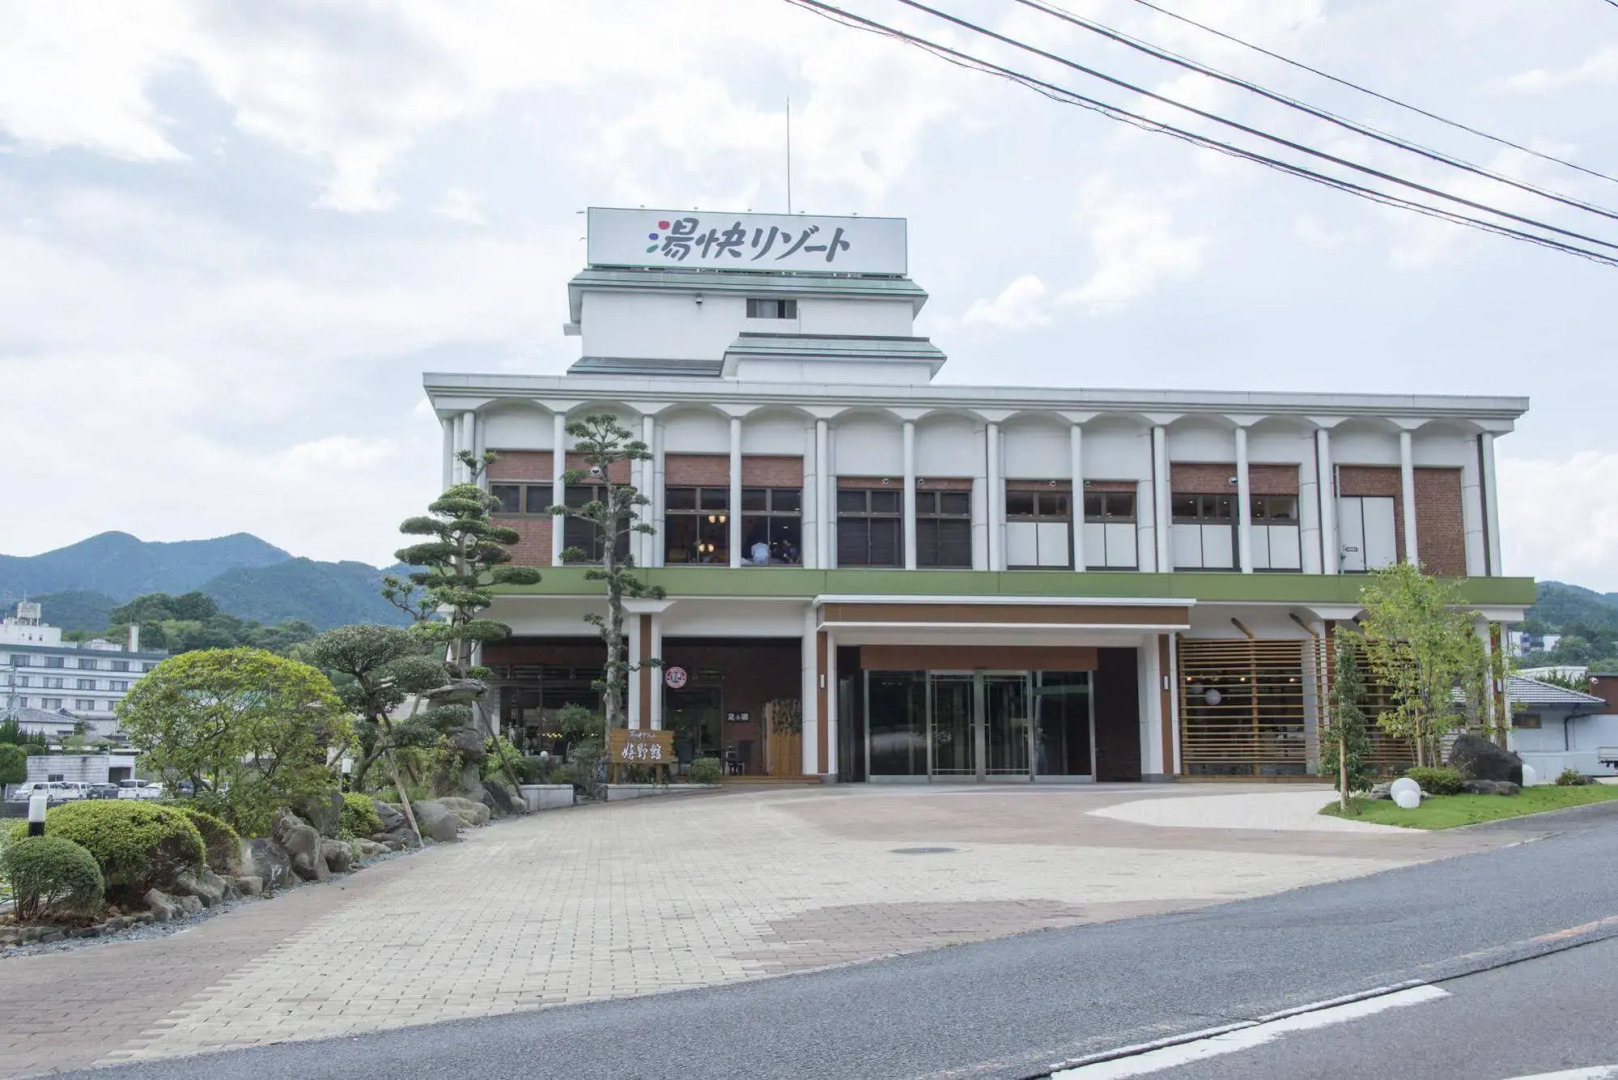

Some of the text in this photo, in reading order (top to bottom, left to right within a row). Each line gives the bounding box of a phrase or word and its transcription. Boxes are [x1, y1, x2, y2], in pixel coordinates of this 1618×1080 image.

[646, 217, 850, 262] 湯快リゾート
